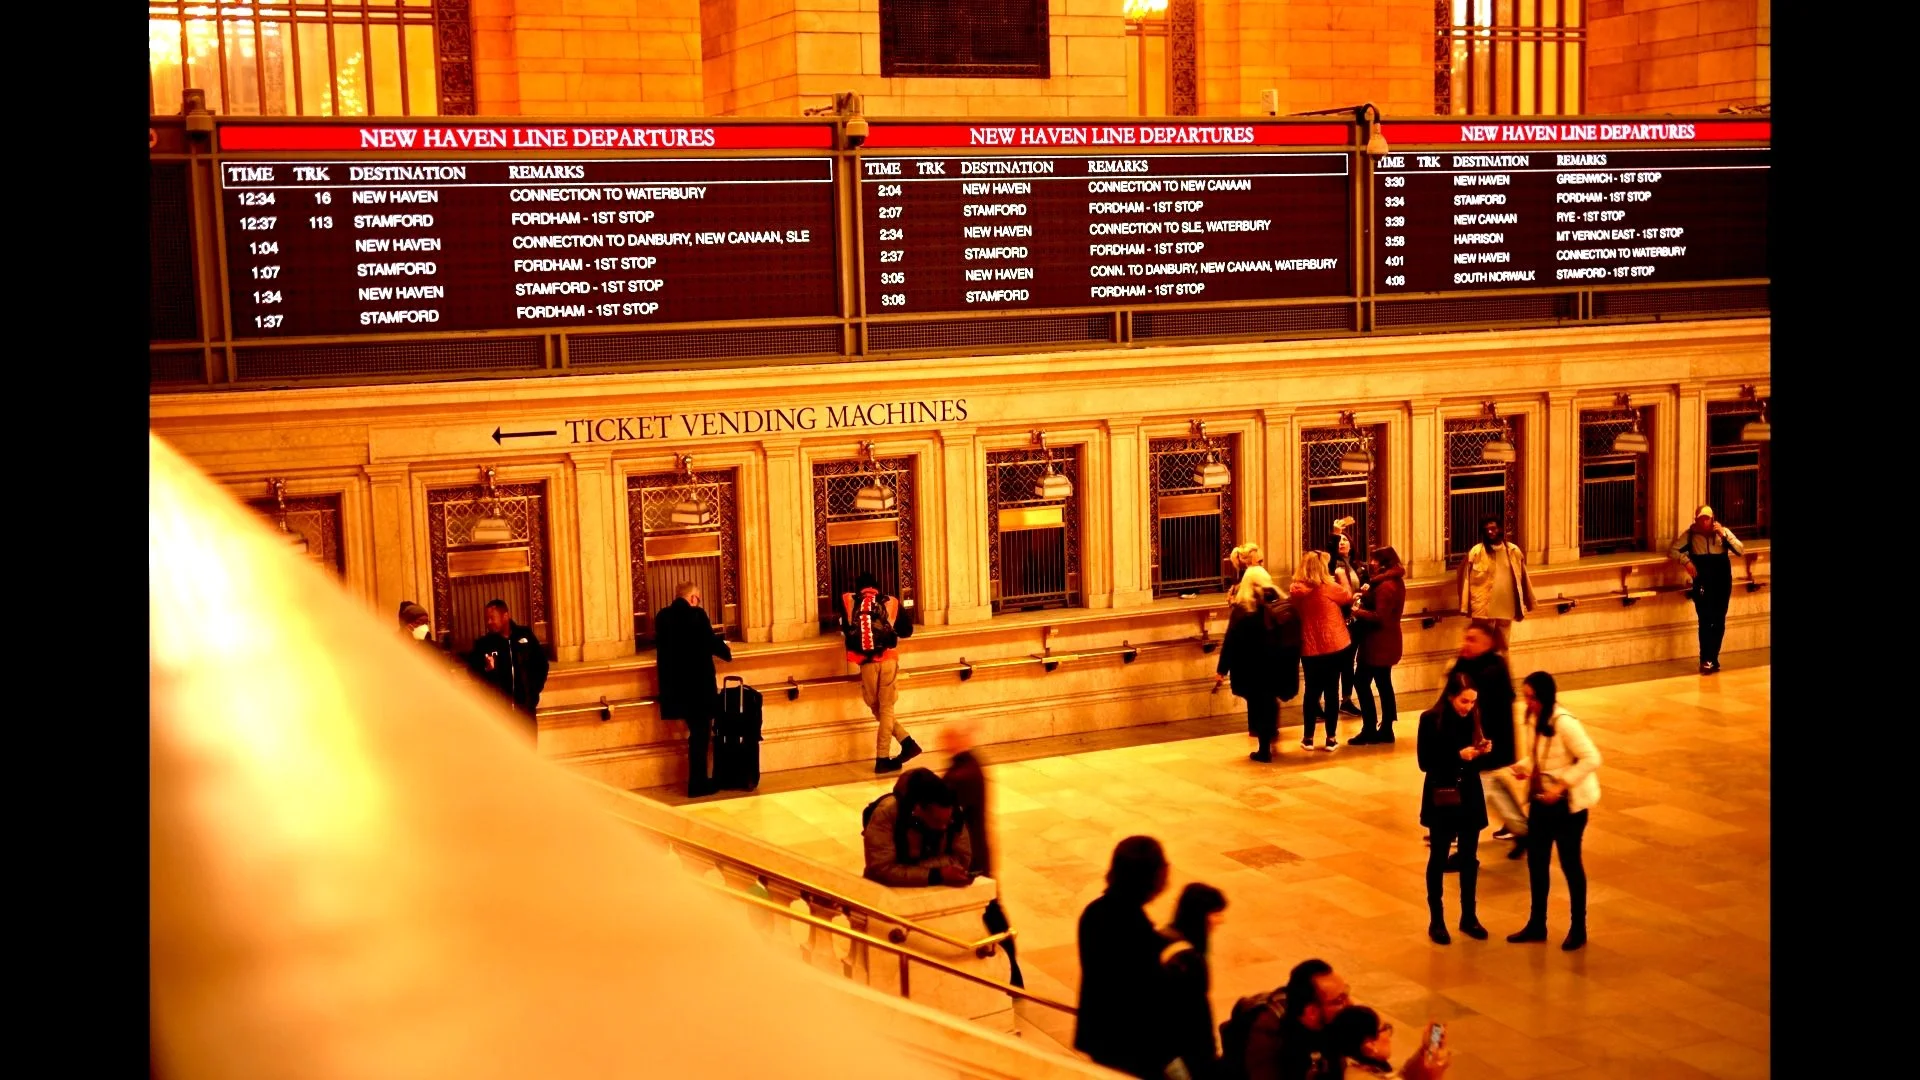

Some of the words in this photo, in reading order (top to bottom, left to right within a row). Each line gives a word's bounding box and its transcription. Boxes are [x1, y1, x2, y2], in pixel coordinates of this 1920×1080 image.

[359, 129, 417, 148] NEW
[423, 129, 507, 147] HAVEN
[512, 129, 568, 147] LINE
[572, 128, 715, 147] DEPARTURES
[970, 127, 1016, 145] NEW
[1020, 127, 1087, 144] HAVEN
[1091, 127, 1136, 144] LINE
[1139, 126, 1254, 144] DEPARTURES
[1461, 125, 1499, 141] NEW
[1502, 125, 1557, 141] HAVEN
[1561, 125, 1597, 140] LINE
[1600, 124, 1695, 140] DEPARTURES
[864, 162, 901, 175] TIME
[916, 161, 946, 175] TRK
[960, 160, 1054, 174] DESTINATION
[1087, 159, 1148, 173] REMARKS
[1416, 155, 1441, 168] TRK
[1453, 155, 1529, 167] DESTINATION
[1556, 154, 1607, 166] REMARKS
[228, 166, 275, 182] TIME
[292, 166, 330, 181] TRK
[349, 166, 466, 181] DESTINATION
[508, 165, 585, 179] REMARKS
[1384, 176, 1405, 188] 3:30
[1453, 175, 1477, 186] NEW
[1478, 174, 1510, 185] HAVEN
[1556, 172, 1613, 184] GREENWICH
[1619, 172, 1636, 183] 1ST
[1637, 171, 1662, 183] STOP
[238, 192, 275, 205] 12:34
[314, 191, 331, 204] 16
[352, 190, 387, 204] NEW
[389, 190, 438, 203] HAVEN
[509, 188, 601, 202] CONNECTION
[602, 187, 623, 200] TO
[624, 186, 706, 200] WATERBURY
[877, 184, 902, 197] 2:04
[962, 182, 990, 195] NEW
[992, 182, 1031, 194] HAVEN
[1088, 180, 1161, 193] CONNECTION
[1162, 179, 1179, 192] TO
[1180, 179, 1206, 192] NEW
[1207, 179, 1251, 191] CANAAN
[1385, 196, 1405, 207] 3:34
[1453, 193, 1506, 206] STAMFORD
[1556, 192, 1603, 204] FORDHAM
[1609, 191, 1626, 202] 1ST
[1627, 190, 1652, 202] STOP
[878, 206, 903, 219] 2:07
[963, 203, 1027, 217] STAMFORD
[1088, 201, 1144, 214] FORDHAM
[1152, 201, 1173, 213] 1ST
[1174, 200, 1203, 213] STOP
[1453, 214, 1477, 225] NEW
[1477, 213, 1517, 225] CANAAN
[1556, 211, 1576, 222] RYE
[1583, 210, 1600, 222] 1ST
[1600, 210, 1626, 222] STOP
[239, 216, 277, 230] 12:37
[309, 216, 333, 229] 113
[354, 214, 434, 229] STAMFORD
[511, 211, 580, 225] FORDHAM
[591, 211, 616, 224] 1ST
[618, 210, 654, 224] STOP
[879, 228, 903, 241] 2:34
[964, 226, 992, 238] NEW
[993, 225, 1032, 237] HAVEN
[1089, 222, 1162, 235] CONNECTION
[1163, 221, 1179, 233] TO
[1181, 221, 1204, 234] SLE,
[1205, 219, 1271, 232] WATERBURY
[1453, 232, 1504, 244] HARRISON
[1556, 230, 1571, 241] MT
[1571, 229, 1610, 241] VERNON
[1611, 228, 1636, 240] EAST
[1642, 228, 1659, 239] 1ST
[1659, 227, 1684, 239] STOP
[249, 241, 279, 255] 1:04
[355, 239, 390, 252] NEW
[392, 238, 441, 251] HAVEN
[512, 234, 603, 249] CONNECTION
[605, 234, 625, 247] TO
[627, 232, 692, 246] DANBURY,
[695, 232, 726, 245] NEW
[727, 230, 783, 244] CANAAN,
[786, 230, 810, 243] SLE
[880, 250, 904, 263] 2:37
[964, 246, 1028, 260] STAMFORD
[1090, 243, 1145, 256] FORDHAM
[1154, 242, 1174, 254] 1ST
[1175, 241, 1204, 254] STOP
[1385, 255, 1403, 266] 4:01
[1453, 253, 1477, 264] NEW
[1478, 252, 1510, 263] HAVEN
[1556, 248, 1617, 261] CONNECTION
[1617, 247, 1631, 258] TO
[1632, 246, 1686, 258] WATERBURY
[251, 265, 280, 279] 1:07
[357, 261, 436, 277] STAMFORD
[514, 258, 583, 272] FORDHAM
[593, 257, 618, 270] 1ST
[620, 256, 656, 270] STOP
[880, 272, 905, 285] 3:05
[965, 269, 993, 281] NEW
[994, 267, 1033, 280] HAVEN
[1090, 264, 1125, 277] CONN.
[1127, 264, 1143, 276] TO
[1145, 262, 1198, 275] DANBURY,
[1200, 261, 1225, 273] NEW
[1226, 260, 1273, 273] CANAAN,
[1274, 258, 1338, 271] WATERBURY
[1453, 272, 1487, 284] SOUTH
[1488, 270, 1535, 282] NORWALK
[1556, 267, 1606, 280] STAMFORD
[1613, 266, 1630, 278] 1ST
[1630, 265, 1655, 277] STOP
[253, 290, 282, 304] 1:34
[358, 287, 393, 300] NEW
[395, 285, 444, 299] HAVEN
[515, 281, 590, 296] STAMFORD
[601, 280, 626, 293] 1ST
[627, 279, 664, 292] STOP
[965, 289, 1029, 303] STAMFORD
[1090, 284, 1146, 298] FORDHAM
[1154, 283, 1174, 296] 1ST
[1175, 283, 1205, 295] STOP
[255, 314, 284, 328] 1:37
[360, 309, 439, 325] STAMFORD
[516, 304, 585, 319] FORDHAM
[595, 303, 620, 316] 1ST
[622, 302, 658, 315] STOP
[565, 414, 672, 443] TICKET
[681, 407, 816, 436] VENDING
[825, 398, 967, 428] MACHINES
